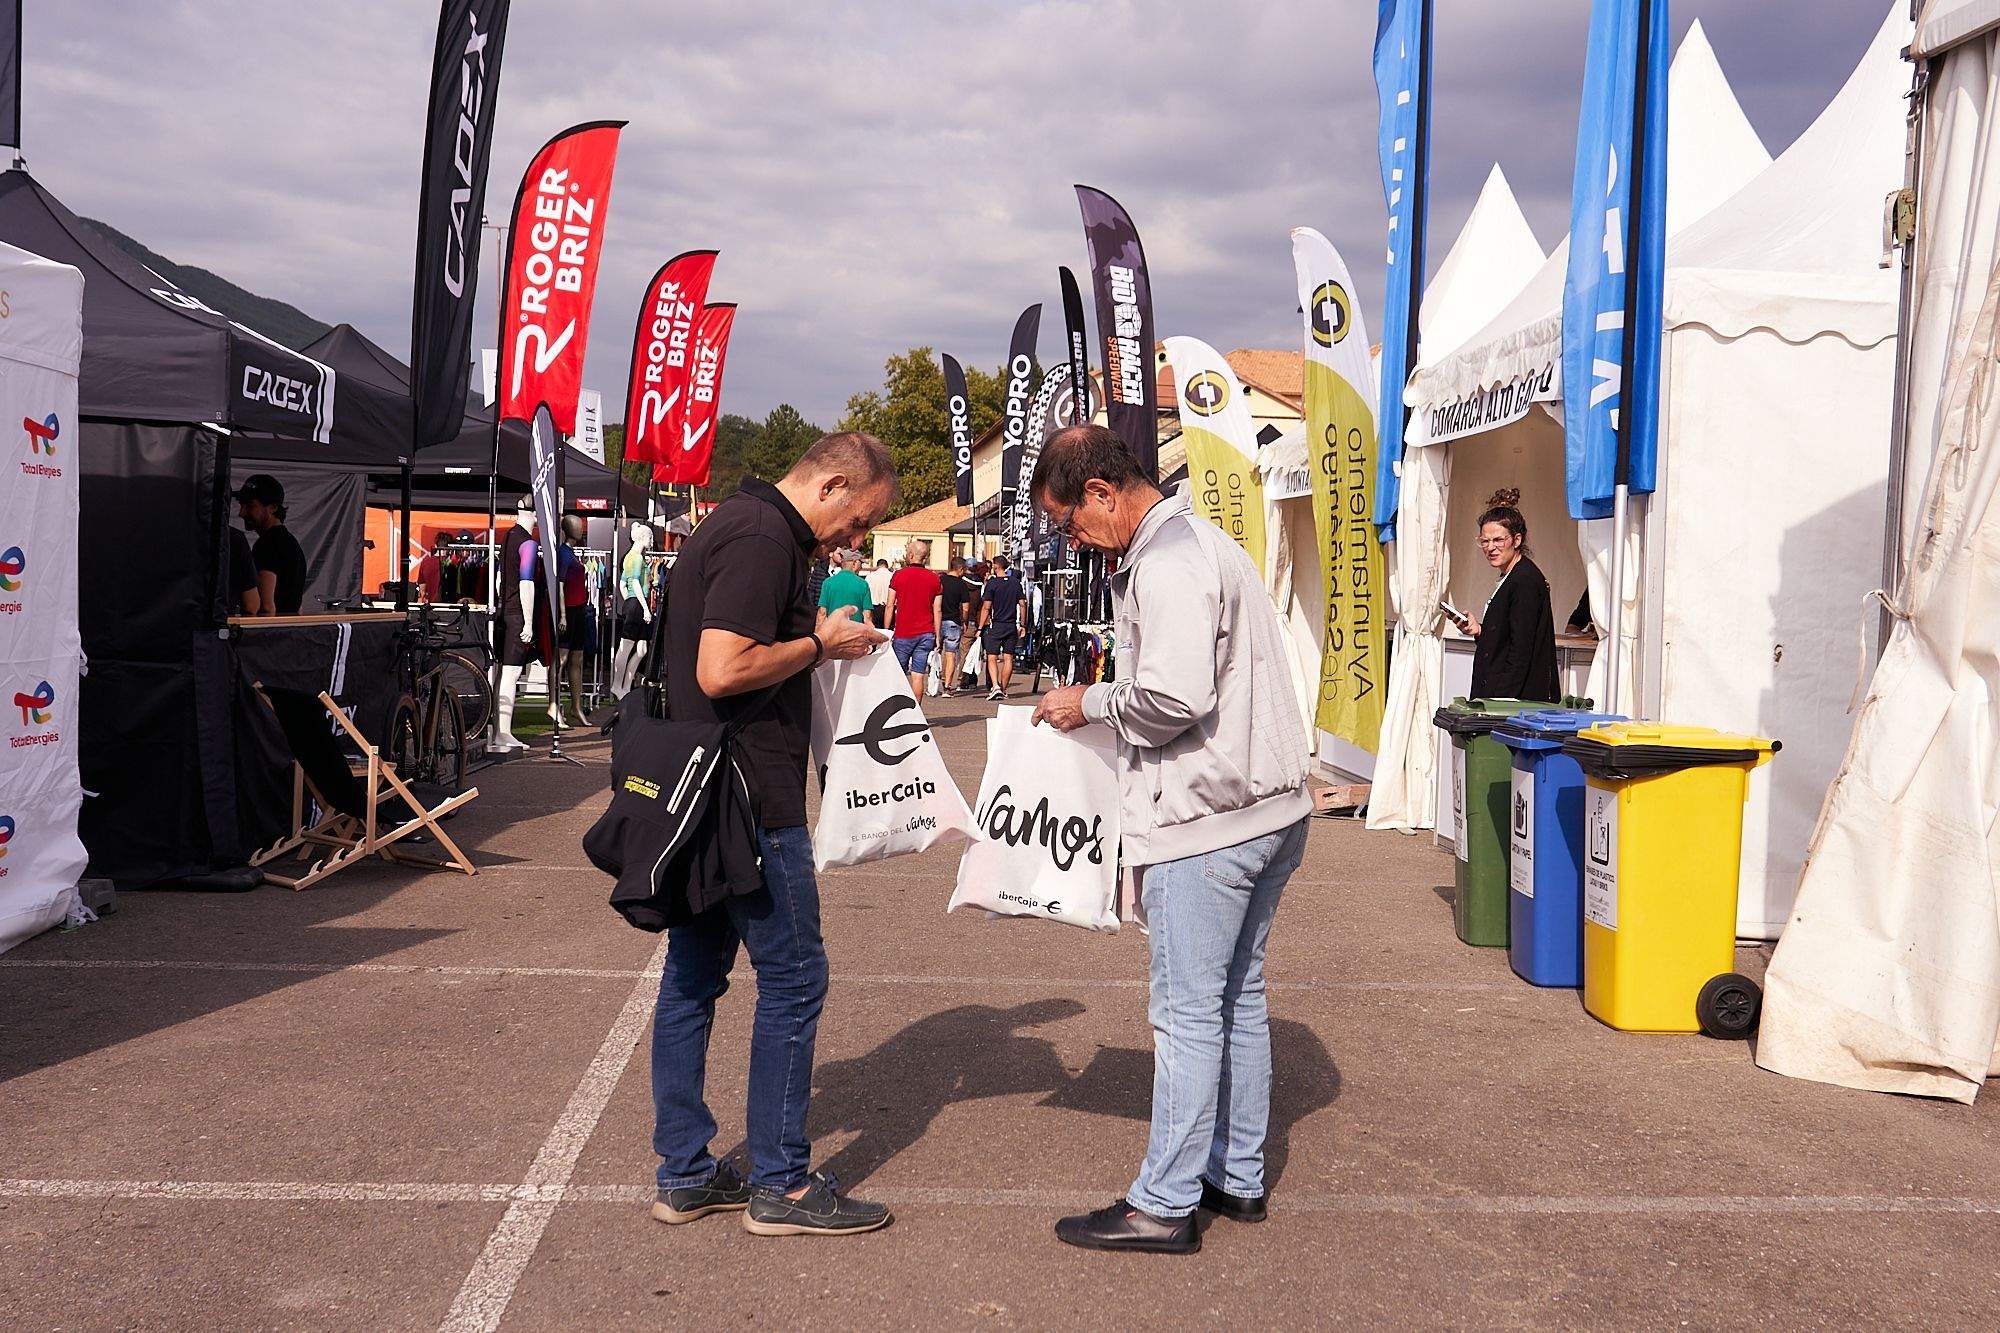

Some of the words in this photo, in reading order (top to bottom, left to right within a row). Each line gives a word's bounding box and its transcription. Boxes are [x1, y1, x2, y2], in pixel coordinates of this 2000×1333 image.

[522, 167, 569, 314] ROGER
[645, 281, 681, 384] ROGER
[242, 365, 313, 415] CADEX
[695, 345, 718, 402] BRIZ
[1107, 336, 1123, 403] SPEEDWEAR
[1431, 394, 1483, 437] COMARCA
[1485, 384, 1514, 424] ALTO
[861, 830, 889, 840] BANCO
[890, 827, 904, 836] DEL
